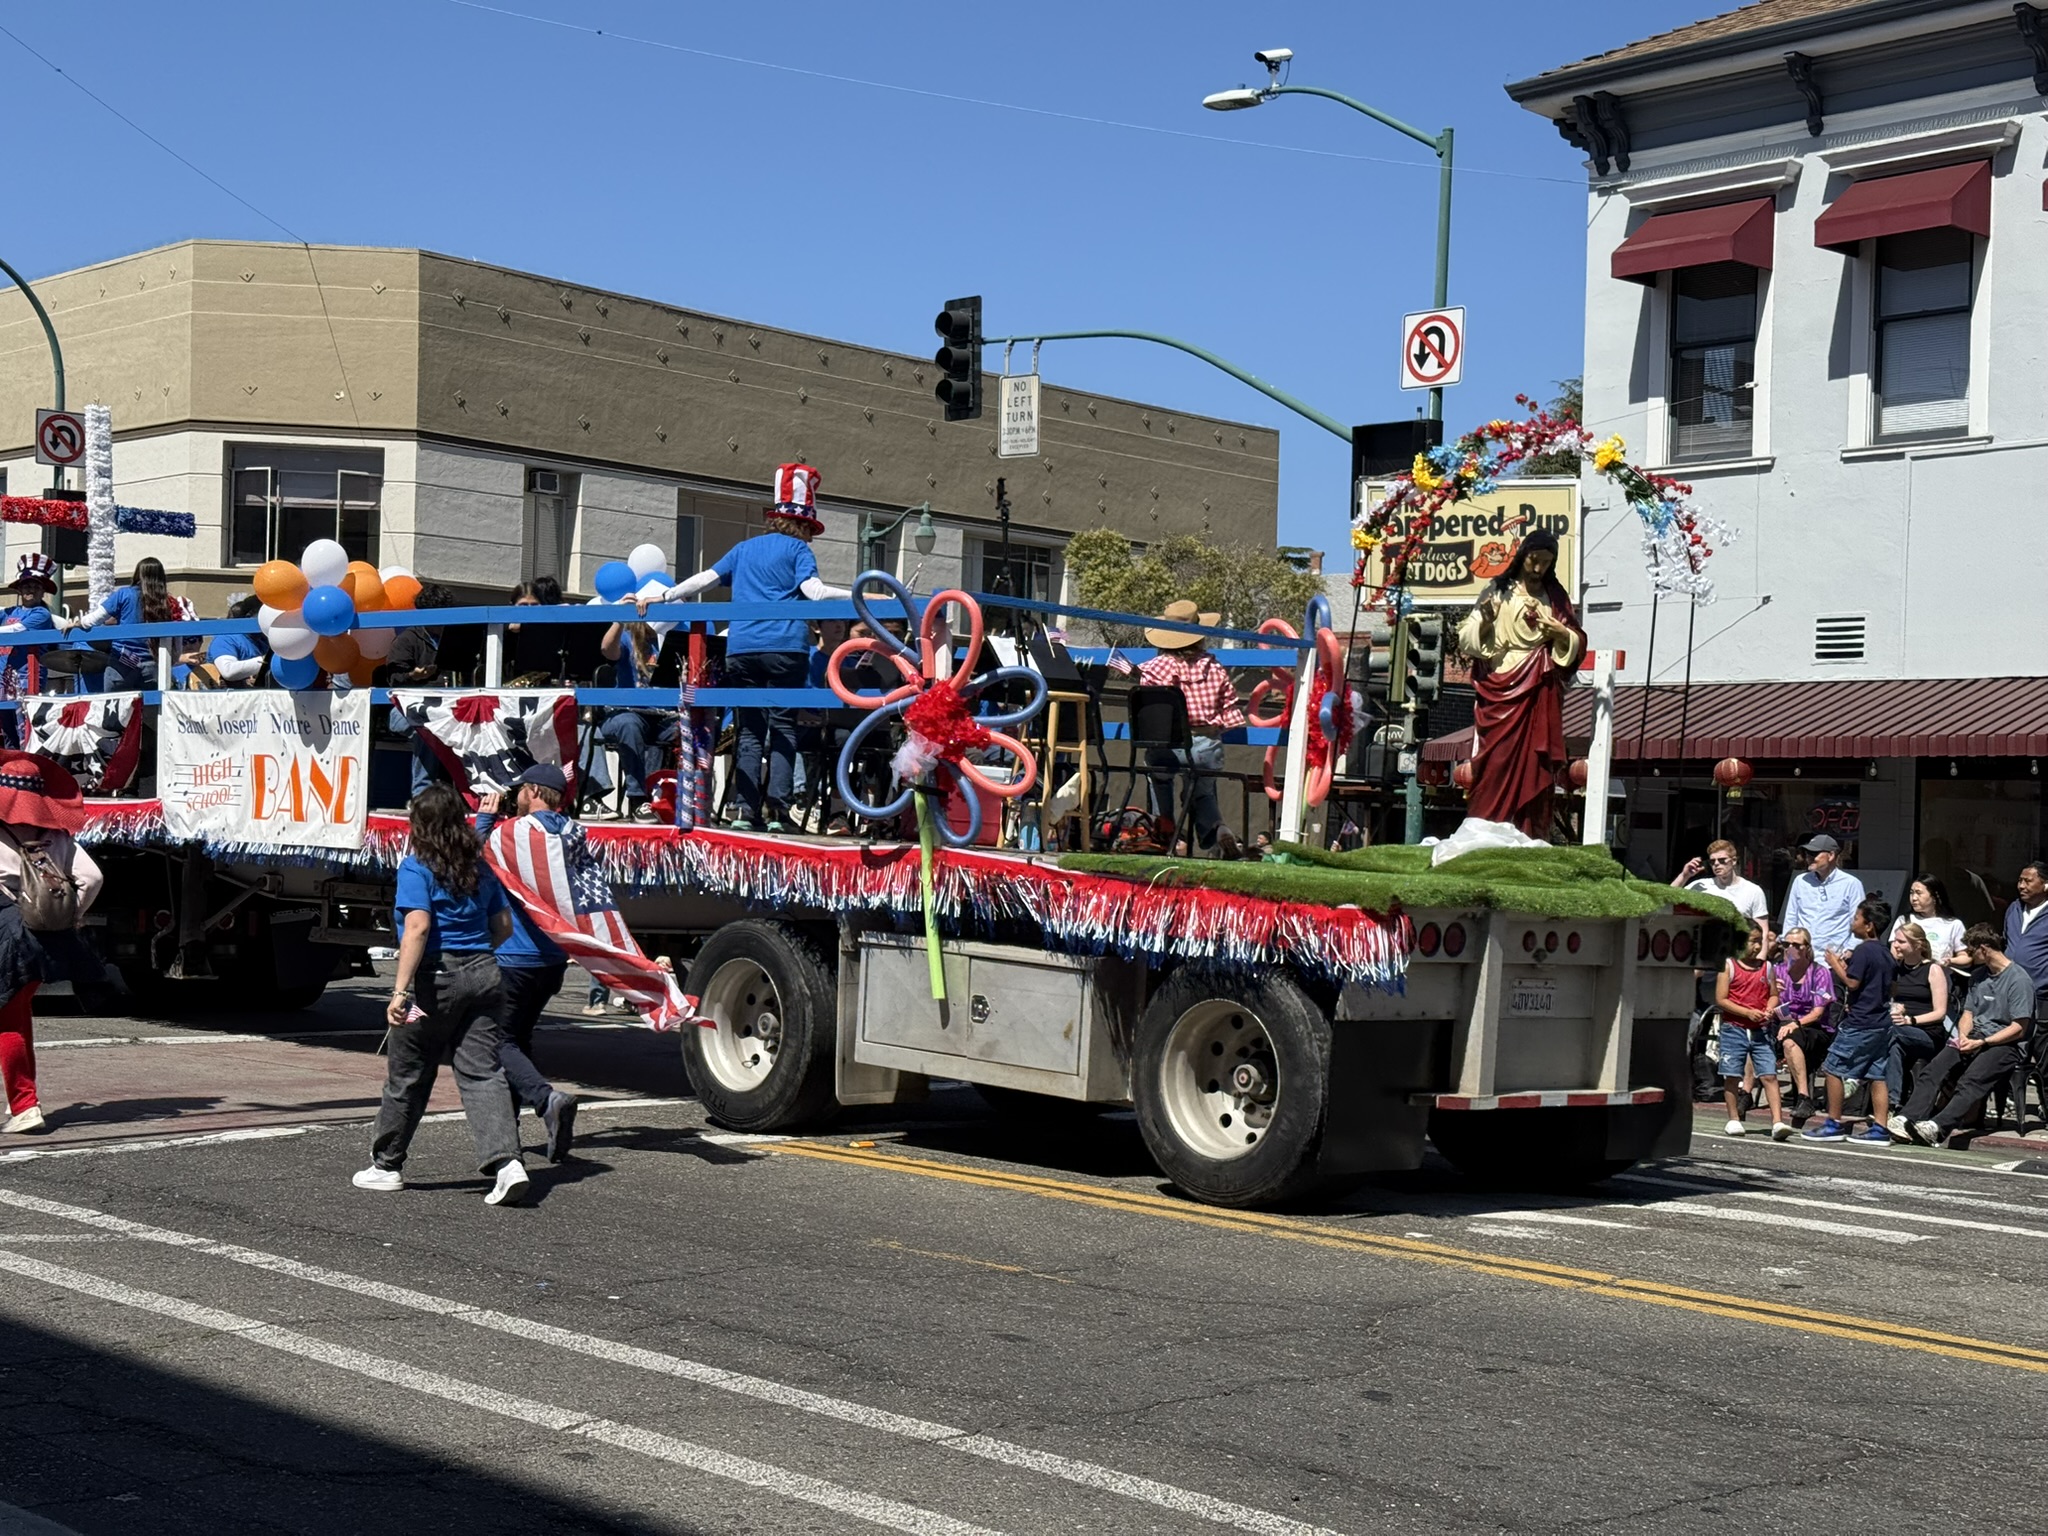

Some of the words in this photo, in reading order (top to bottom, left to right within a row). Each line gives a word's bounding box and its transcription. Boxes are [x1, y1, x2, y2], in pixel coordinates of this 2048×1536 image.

[1013, 381, 1027, 392] NO
[1007, 395, 1033, 408] LEFT
[1006, 411, 1033, 423] TURN
[1518, 503, 1570, 540] Pup
[1424, 555, 1468, 582] DOGS
[177, 713, 208, 734] Saint
[216, 712, 258, 738] Joseph
[270, 713, 312, 735] Notre
[319, 714, 360, 736] Dame
[192, 757, 232, 788] HIGH
[186, 786, 234, 814] SCHOOL
[250, 752, 361, 825] BAND
